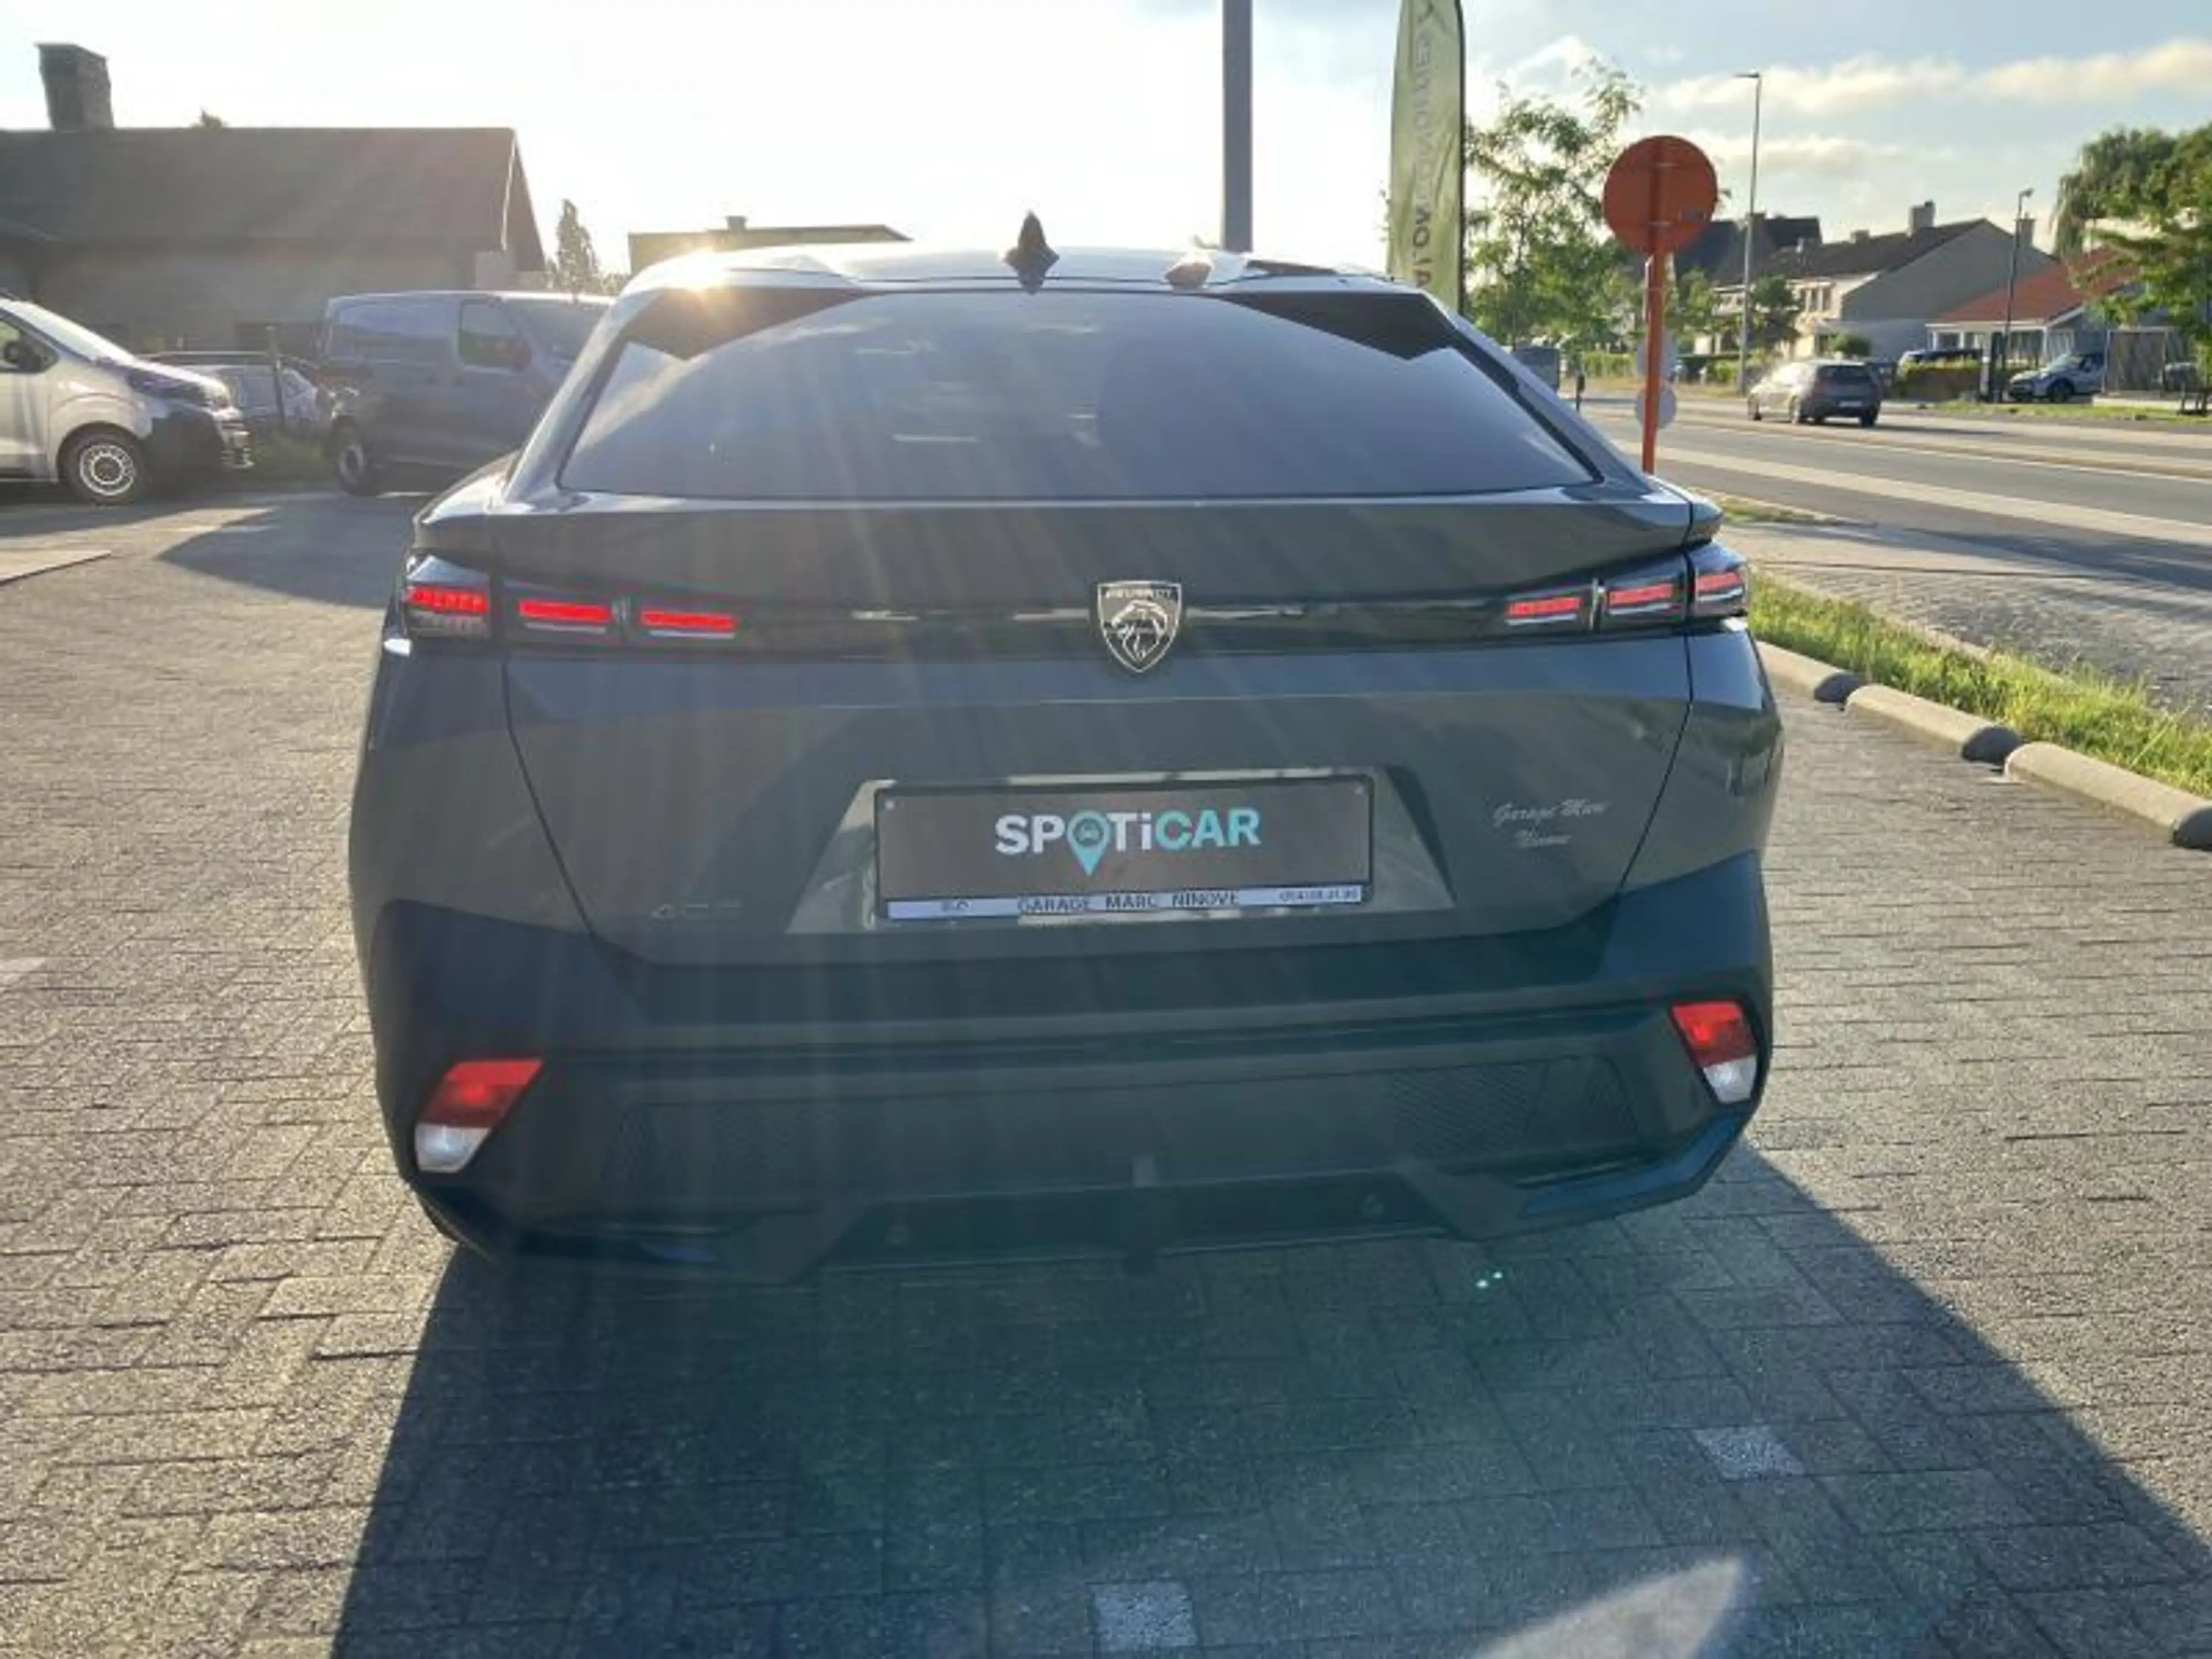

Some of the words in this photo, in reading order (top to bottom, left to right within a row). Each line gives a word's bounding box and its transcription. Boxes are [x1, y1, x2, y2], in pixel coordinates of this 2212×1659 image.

[1017, 896, 1089, 913] GARAGE
[1105, 893, 1158, 911] MARC
[1172, 891, 1238, 907] NINOVE
